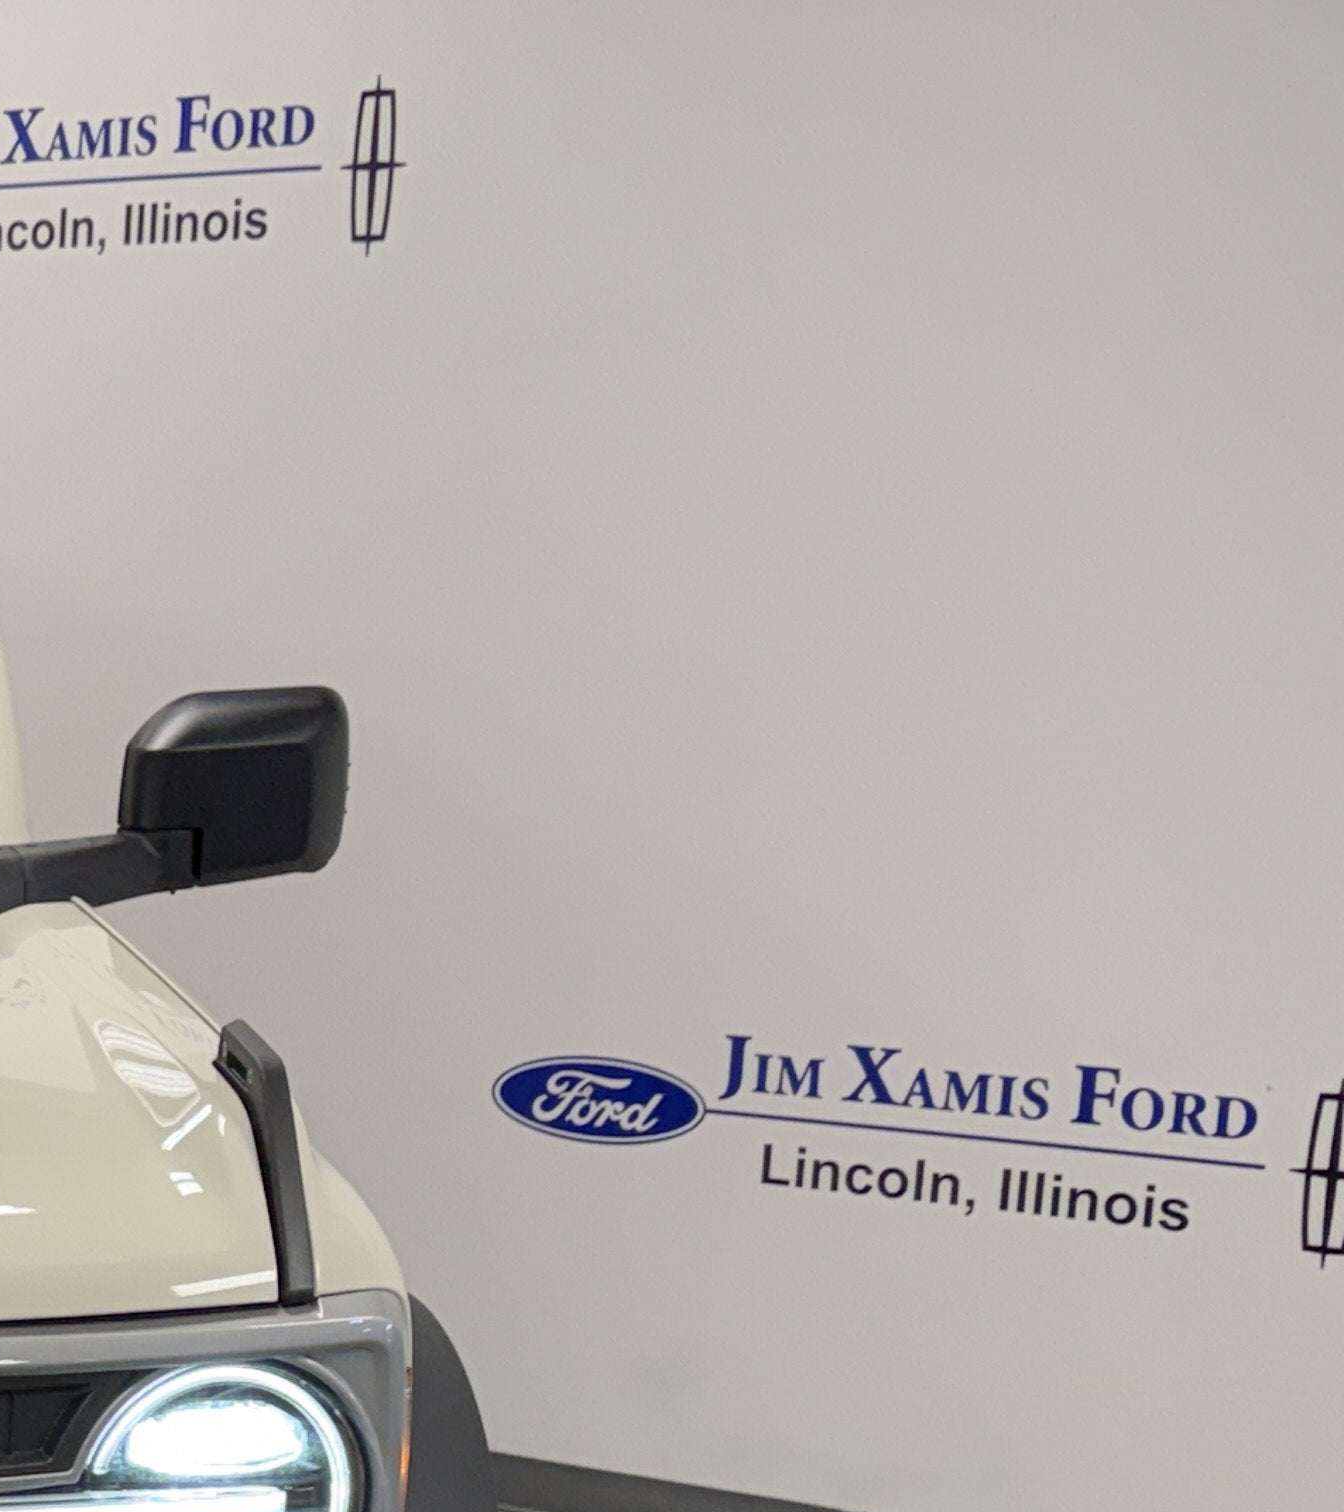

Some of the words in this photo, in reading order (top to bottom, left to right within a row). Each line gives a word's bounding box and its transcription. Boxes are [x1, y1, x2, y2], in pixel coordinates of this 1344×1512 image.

[1, 108, 156, 164] XAMIS
[175, 96, 314, 152] FORD
[125, 199, 267, 244] Illinois
[532, 1071, 662, 1132] Ford
[719, 1036, 824, 1099] JIM
[842, 1046, 1048, 1119] XAMIS
[1071, 1066, 1257, 1138] FORD
[762, 1144, 974, 1215] Lincoln,
[1000, 1169, 1188, 1231] Illinois
